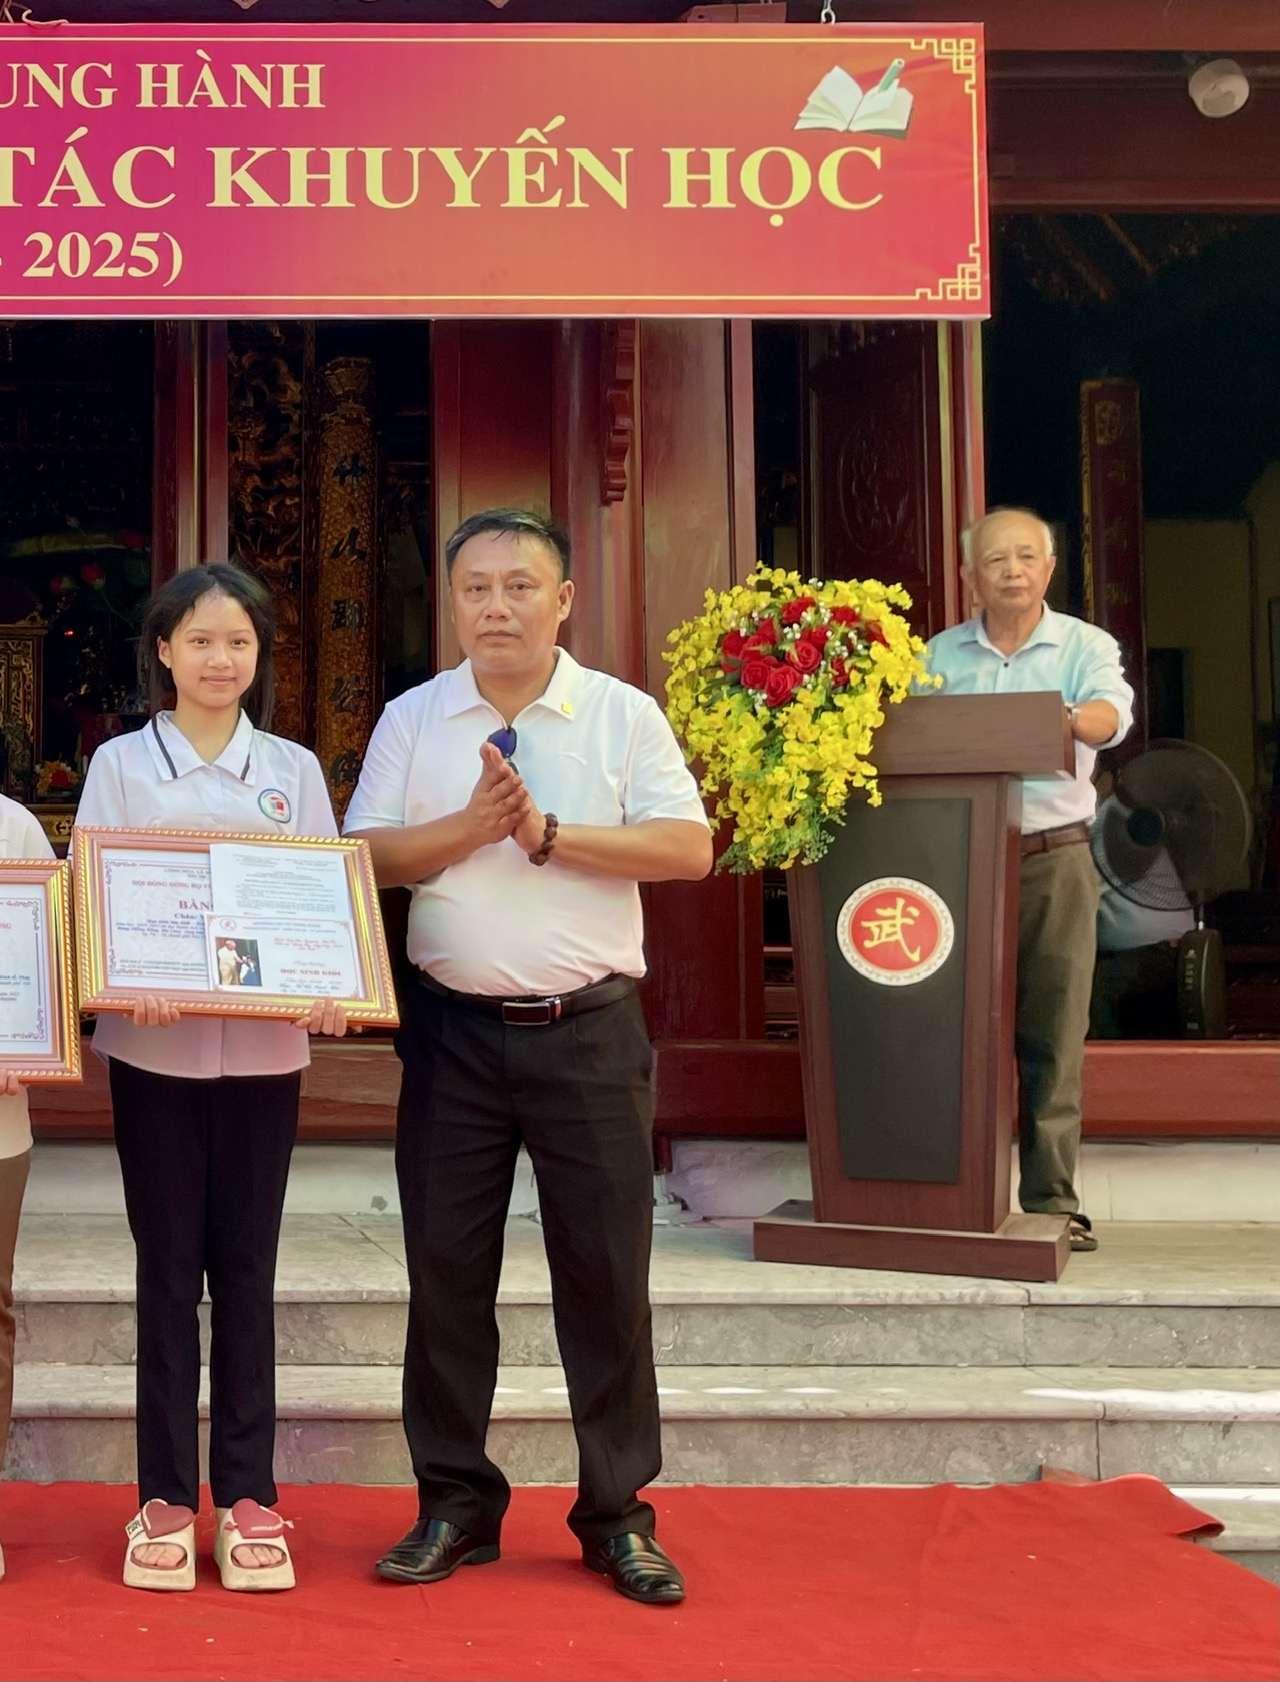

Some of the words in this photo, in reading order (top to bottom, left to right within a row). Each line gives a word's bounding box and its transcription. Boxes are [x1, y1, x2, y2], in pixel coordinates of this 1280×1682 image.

[135, 48, 326, 109] HÀNH
[205, 115, 634, 210] KHUYẾN
[661, 146, 884, 228] HỌC
[22, 231, 183, 288] 2025)
[178, 898, 213, 911] BẰN
[860, 897, 921, 963] 武
